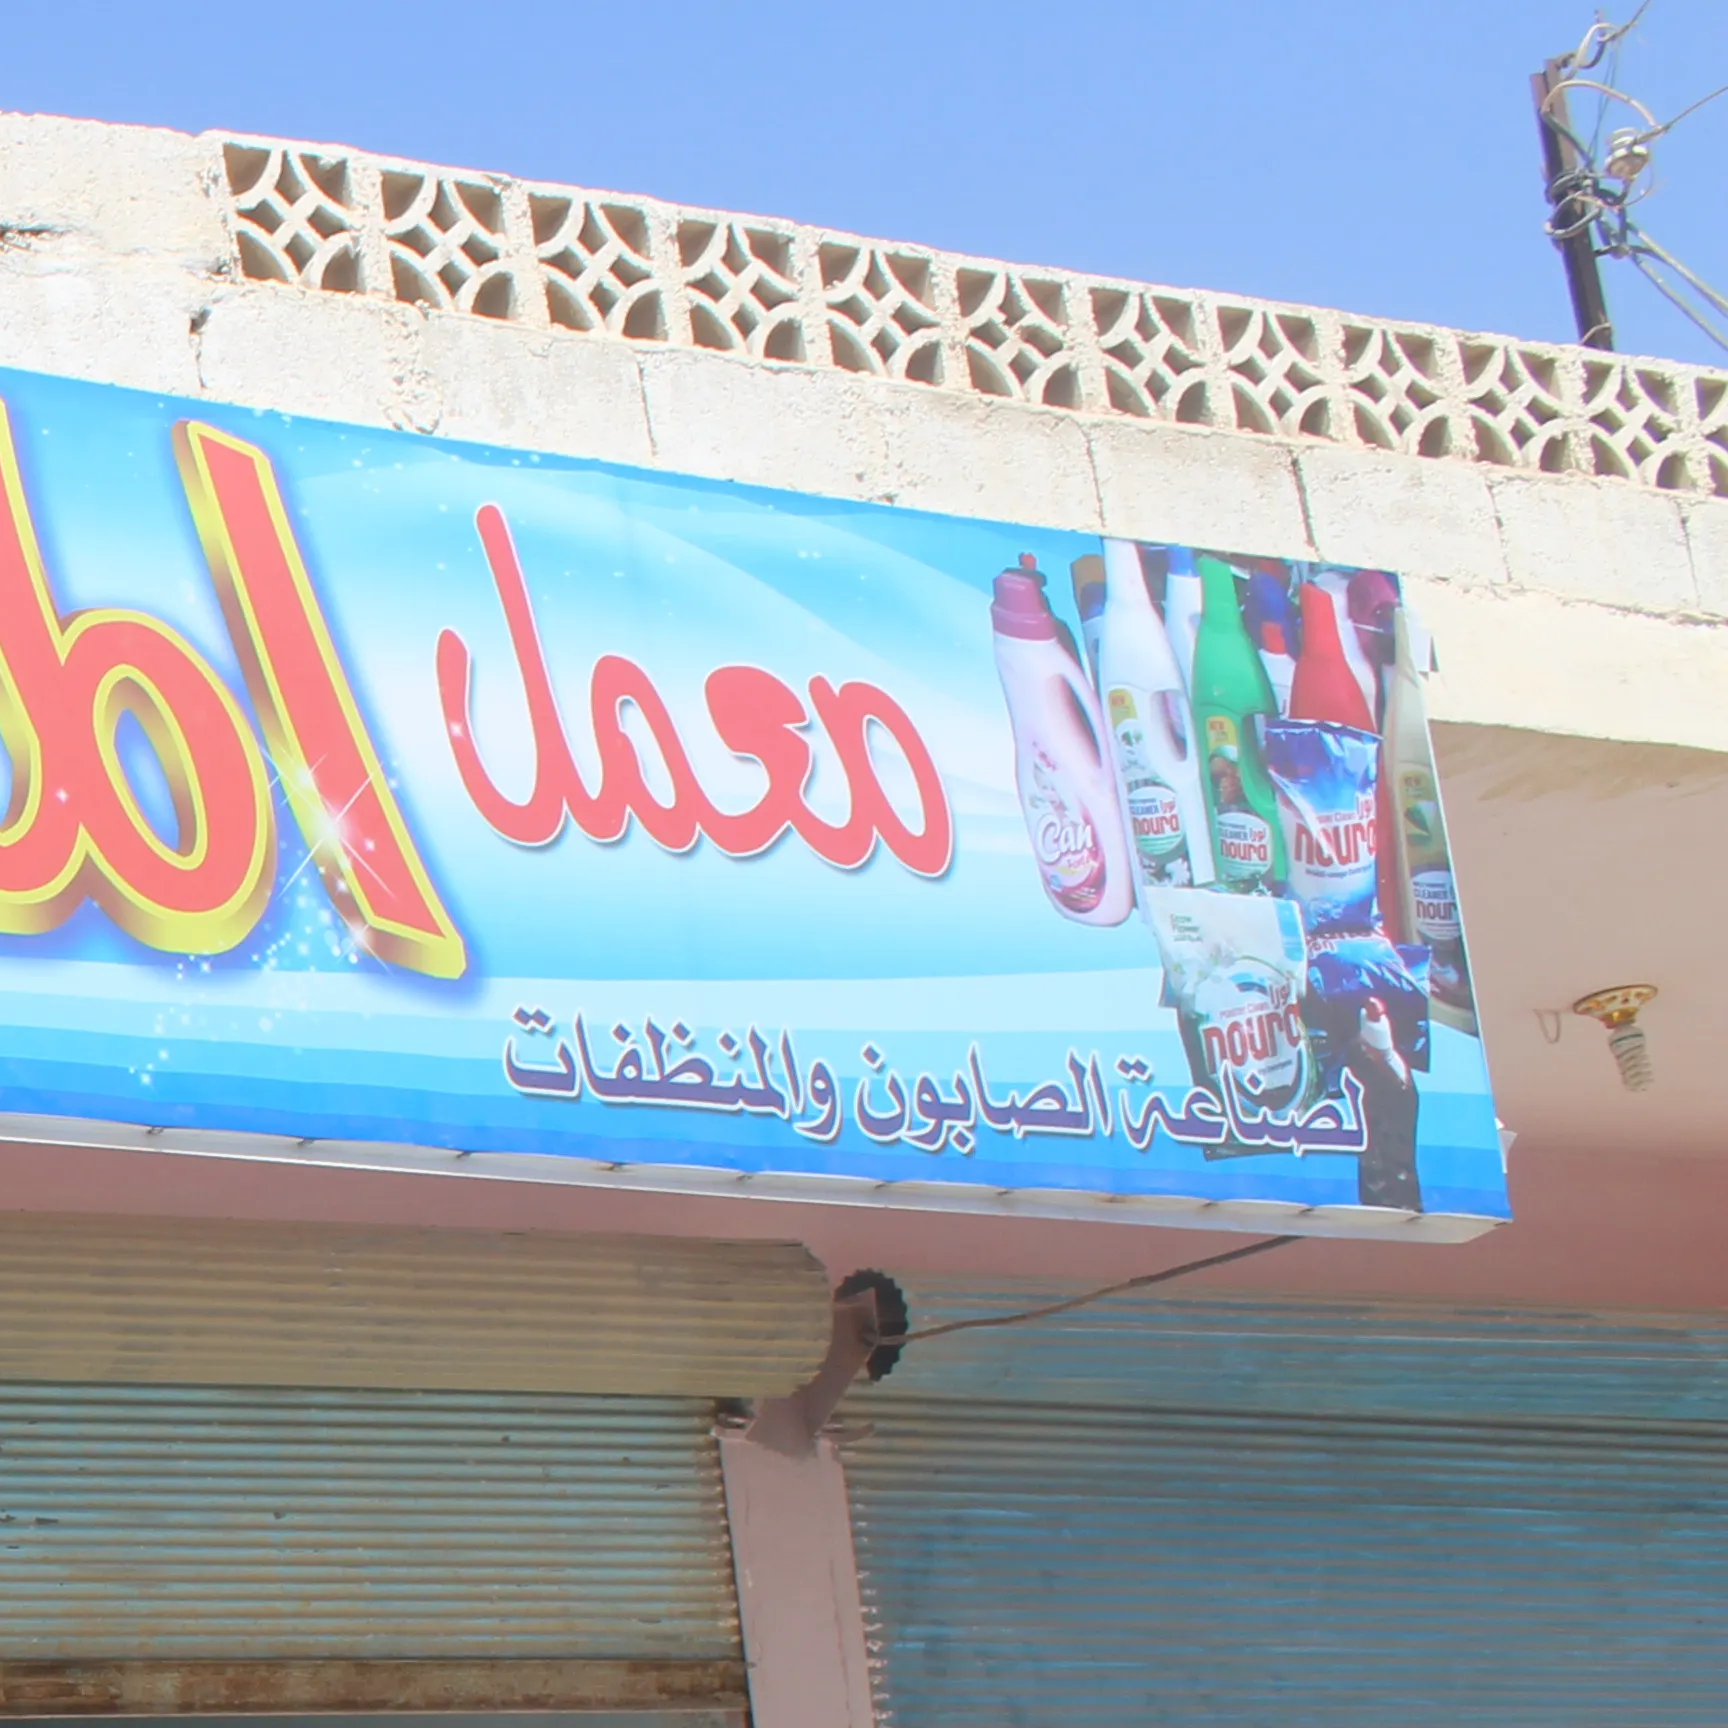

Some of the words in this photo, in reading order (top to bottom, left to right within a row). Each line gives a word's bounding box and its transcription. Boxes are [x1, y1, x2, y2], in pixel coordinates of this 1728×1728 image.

[435, 502, 953, 878] معمل
[1035, 812, 1093, 864] Can
[1131, 813, 1181, 837] noura
[1220, 839, 1268, 863] noura
[1416, 901, 1458, 921] nour
[505, 1006, 842, 1139] والمنظفات
[1201, 1002, 1301, 1075] noura
[856, 1044, 1113, 1153] الصابون
[1121, 1056, 1367, 1155] لصناعة
